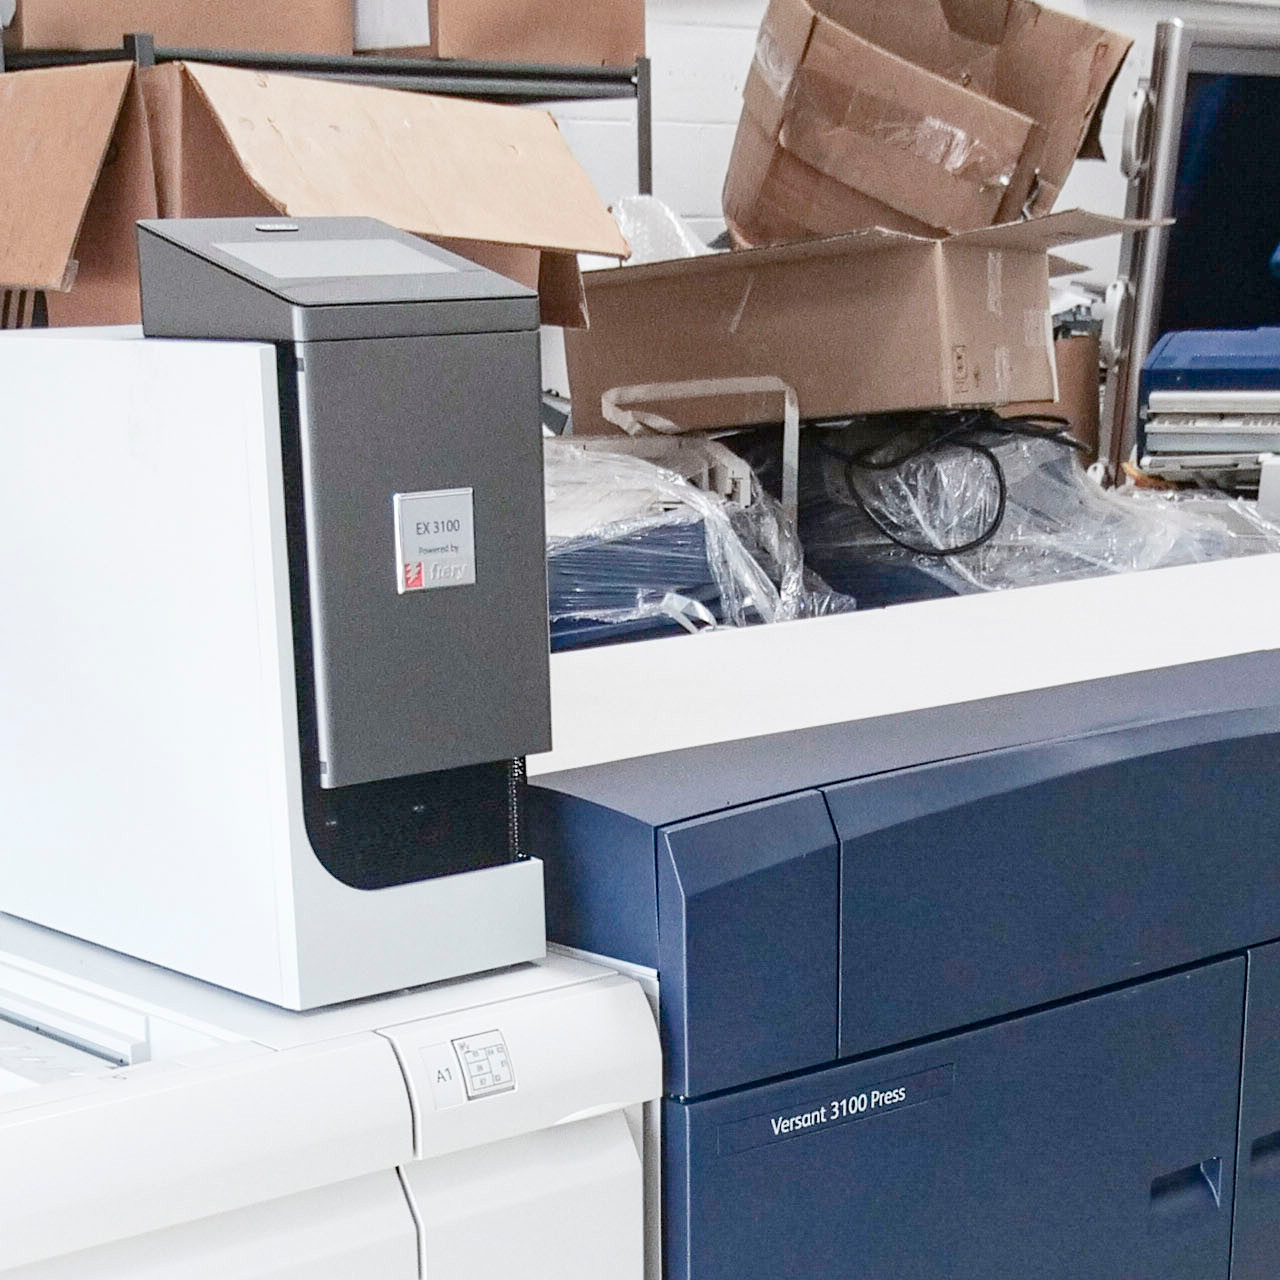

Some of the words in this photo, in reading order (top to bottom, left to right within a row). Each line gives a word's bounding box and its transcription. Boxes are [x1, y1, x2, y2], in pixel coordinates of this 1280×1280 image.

[416, 521, 430, 535] EX
[433, 519, 461, 534] 3100
[418, 544, 449, 555] Powered
[450, 543, 459, 553] by
[437, 1067, 453, 1084] A1
[771, 1106, 827, 1136] Versant
[830, 1094, 868, 1120] 3100
[871, 1087, 906, 1109] Press
